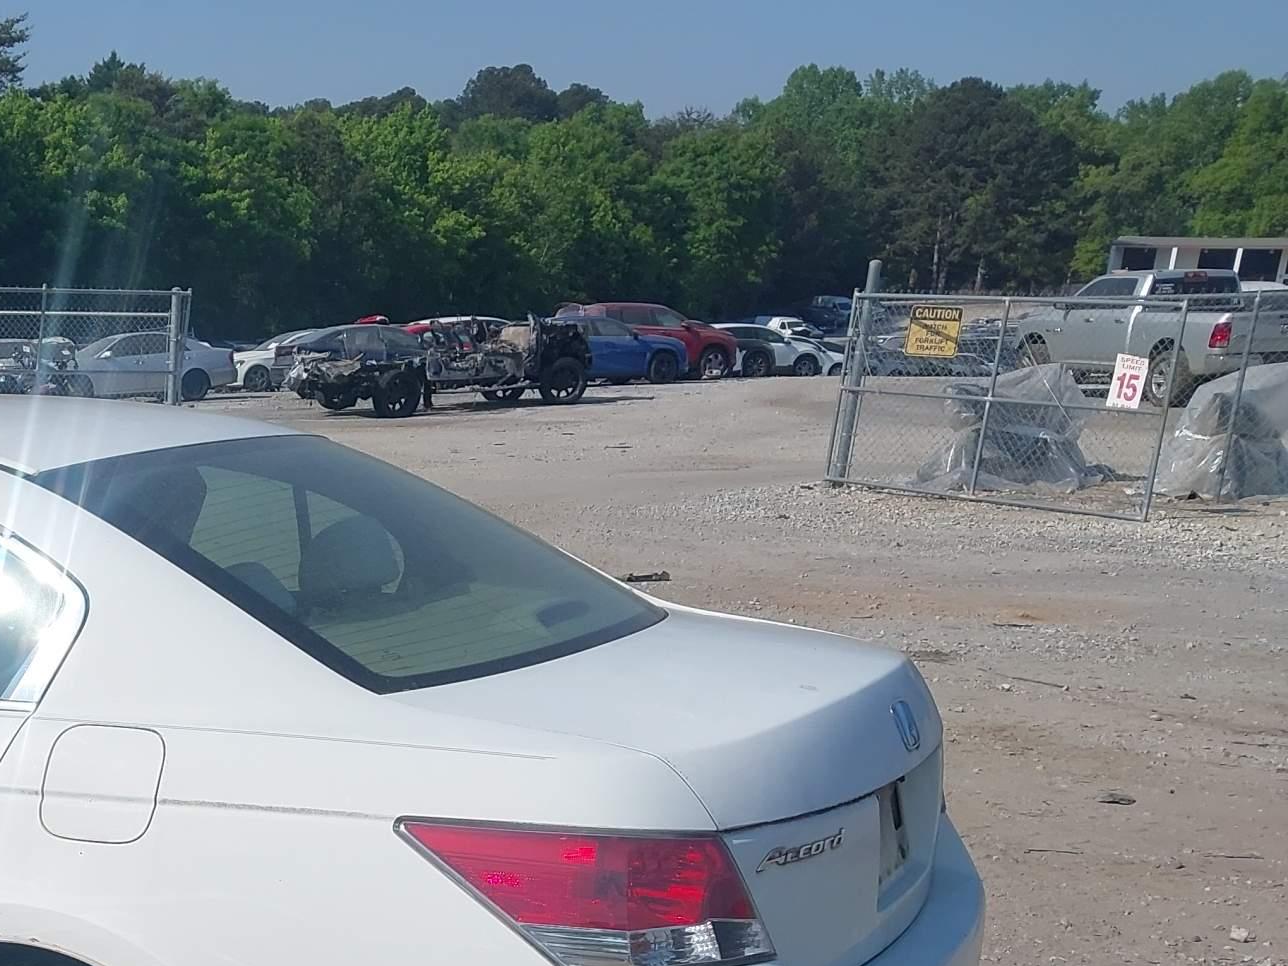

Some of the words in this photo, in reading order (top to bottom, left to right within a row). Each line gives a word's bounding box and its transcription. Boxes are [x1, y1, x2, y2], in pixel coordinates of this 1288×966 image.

[915, 308, 960, 320] CAUTION
[915, 337, 949, 345] FORKLIFT
[916, 344, 946, 352] TRAFFIC
[1121, 357, 1145, 366] SPEED
[1122, 363, 1143, 371] LIMIT
[1117, 372, 1141, 401] 15
[756, 827, 846, 873] Accord
